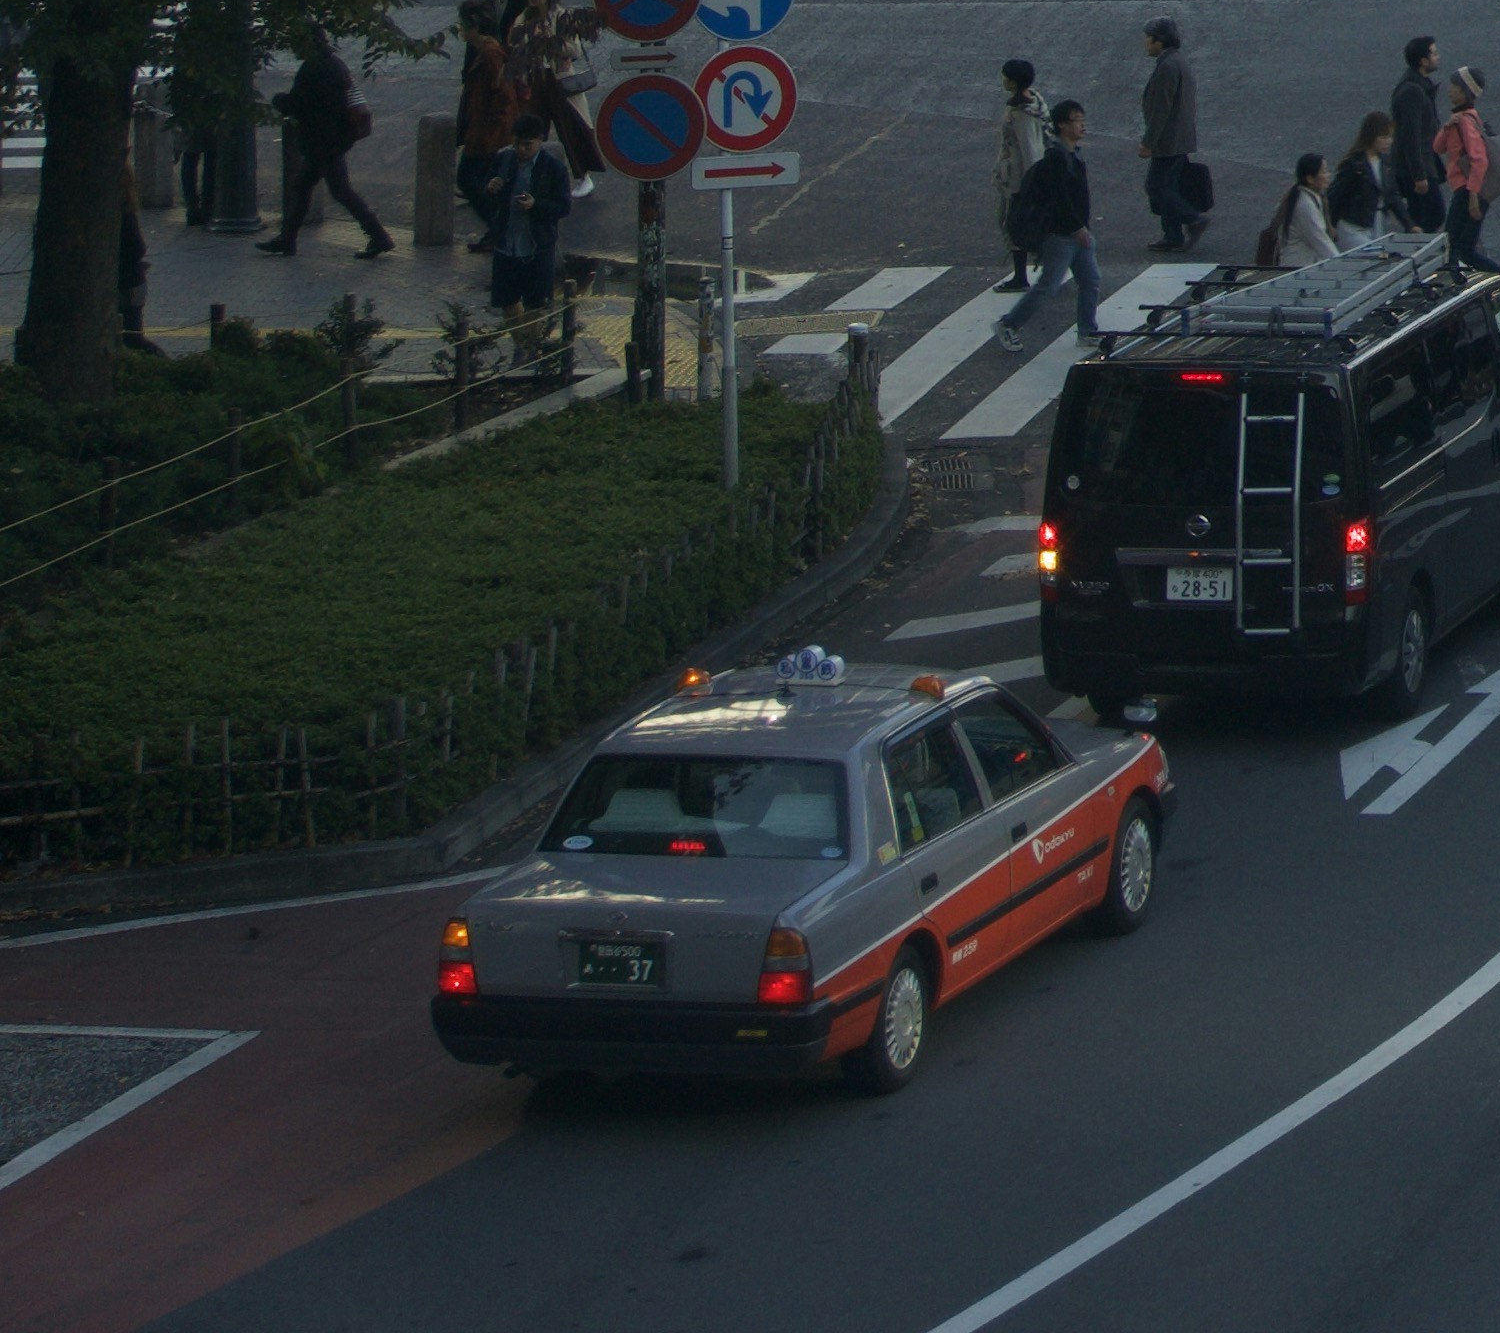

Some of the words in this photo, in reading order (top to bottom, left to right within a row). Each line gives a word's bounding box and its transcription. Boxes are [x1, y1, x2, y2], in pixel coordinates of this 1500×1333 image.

[1180, 580, 1228, 600] 28-51
[1044, 826, 1075, 854] odakyu
[628, 959, 654, 982] 37
